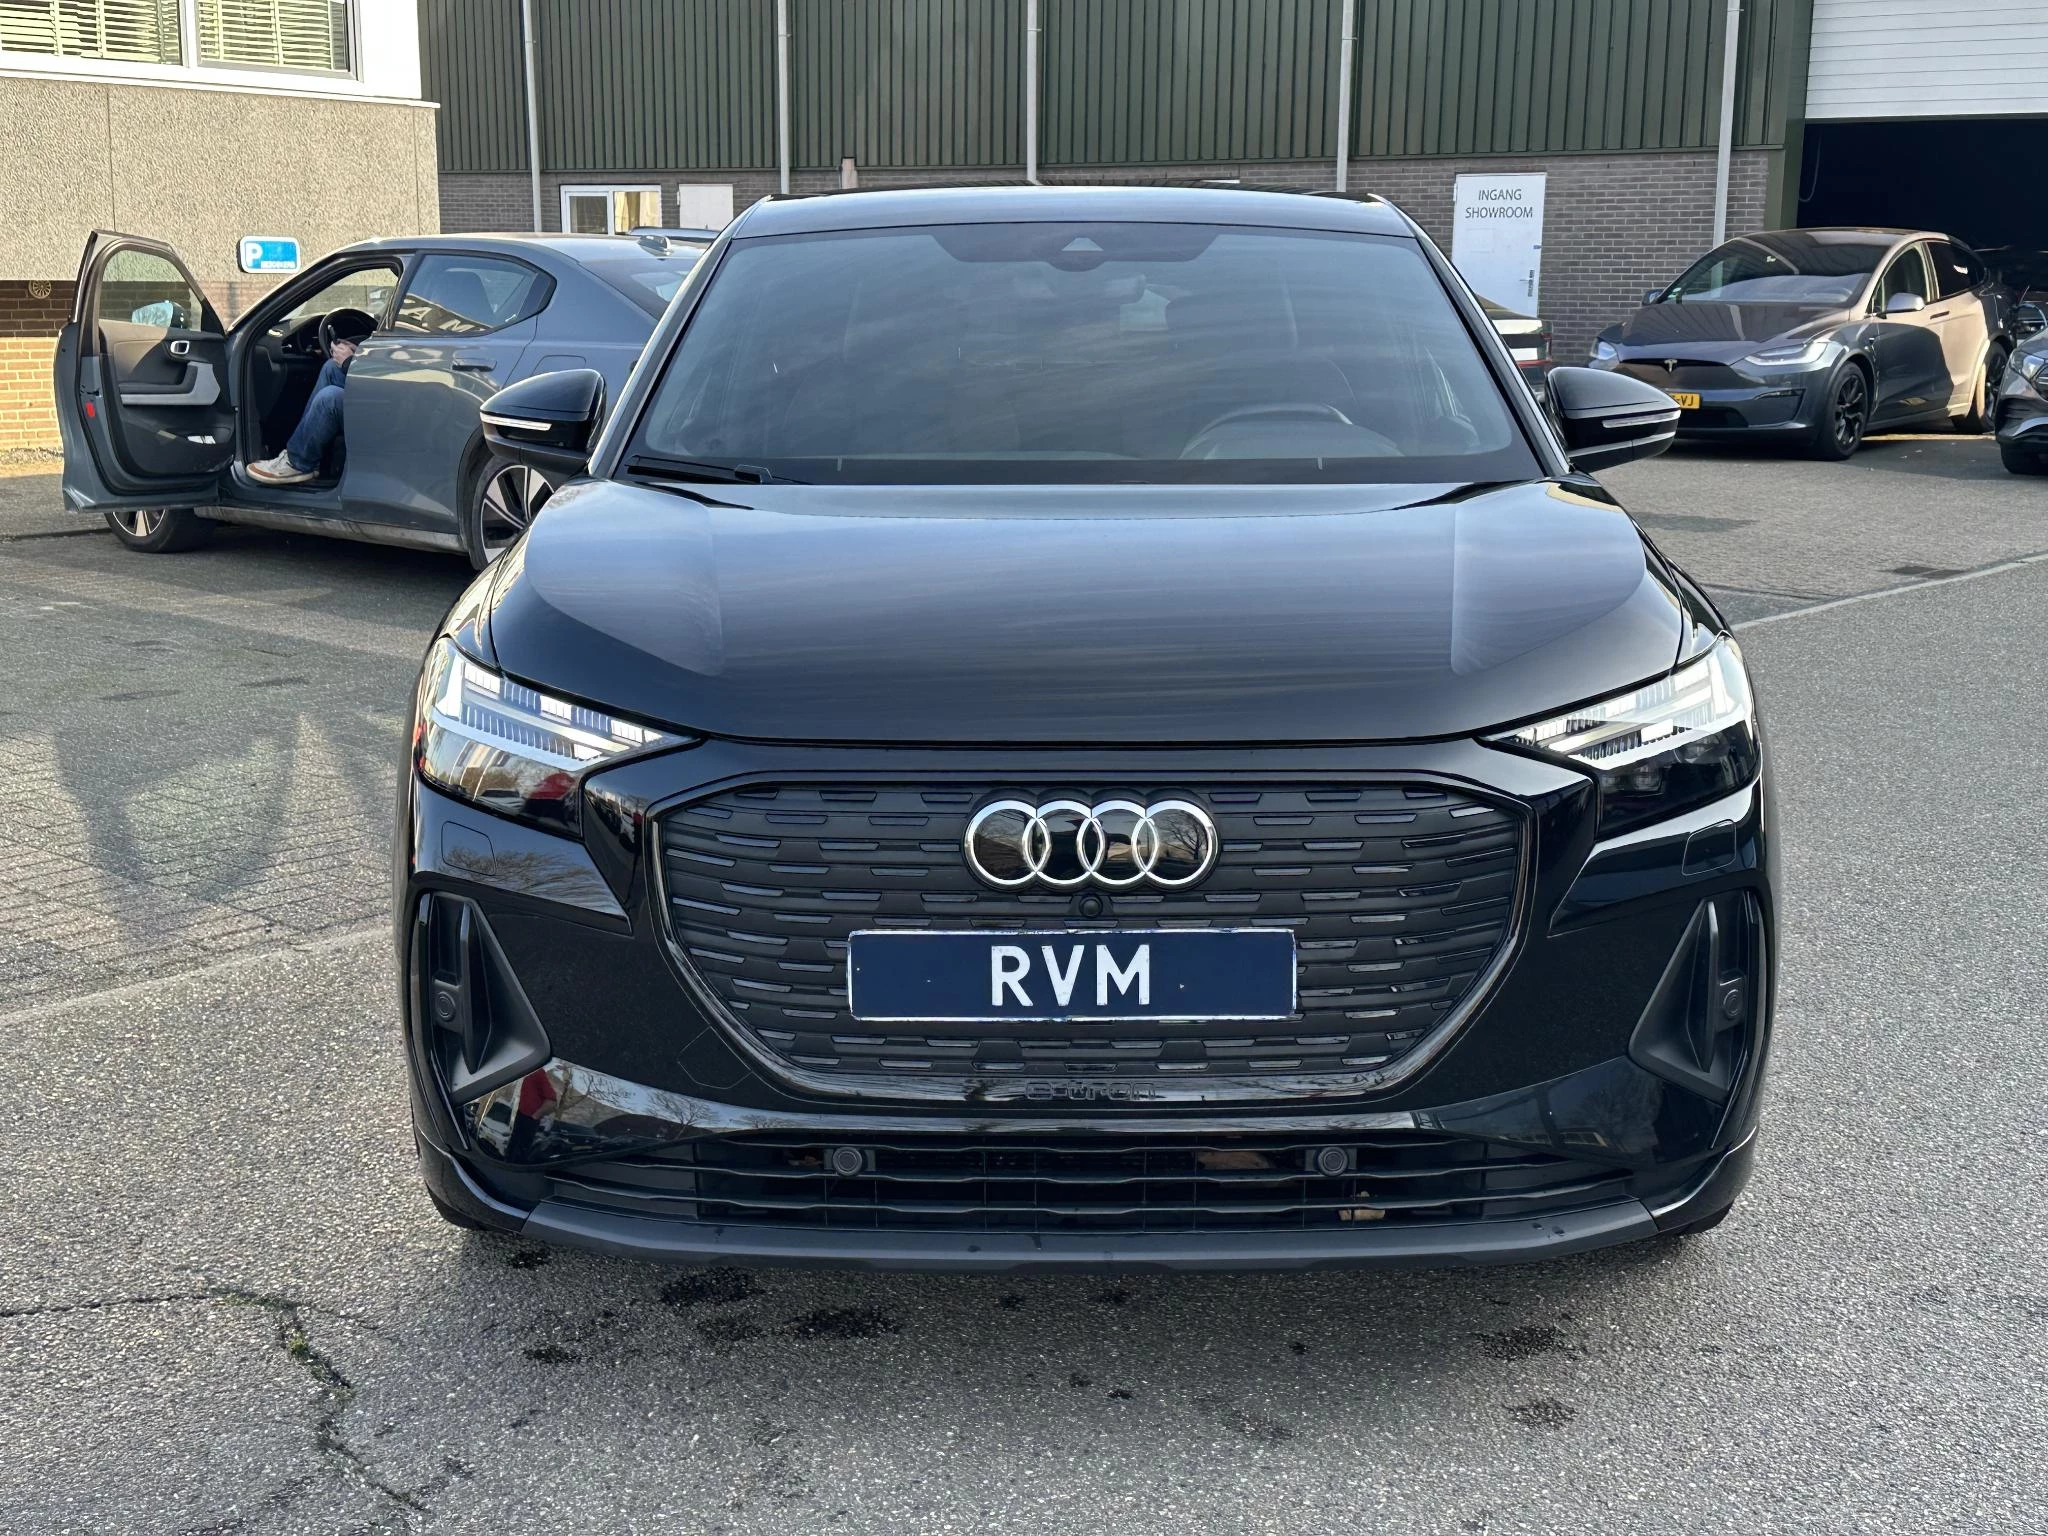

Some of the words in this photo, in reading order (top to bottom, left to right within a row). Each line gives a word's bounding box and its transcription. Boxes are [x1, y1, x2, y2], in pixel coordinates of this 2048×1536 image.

[1478, 189, 1522, 201] INGANG
[1465, 206, 1533, 219] SHOWROOM
[245, 242, 263, 267] P
[1672, 394, 1694, 407] -VJ
[990, 944, 1151, 1007] RVM
